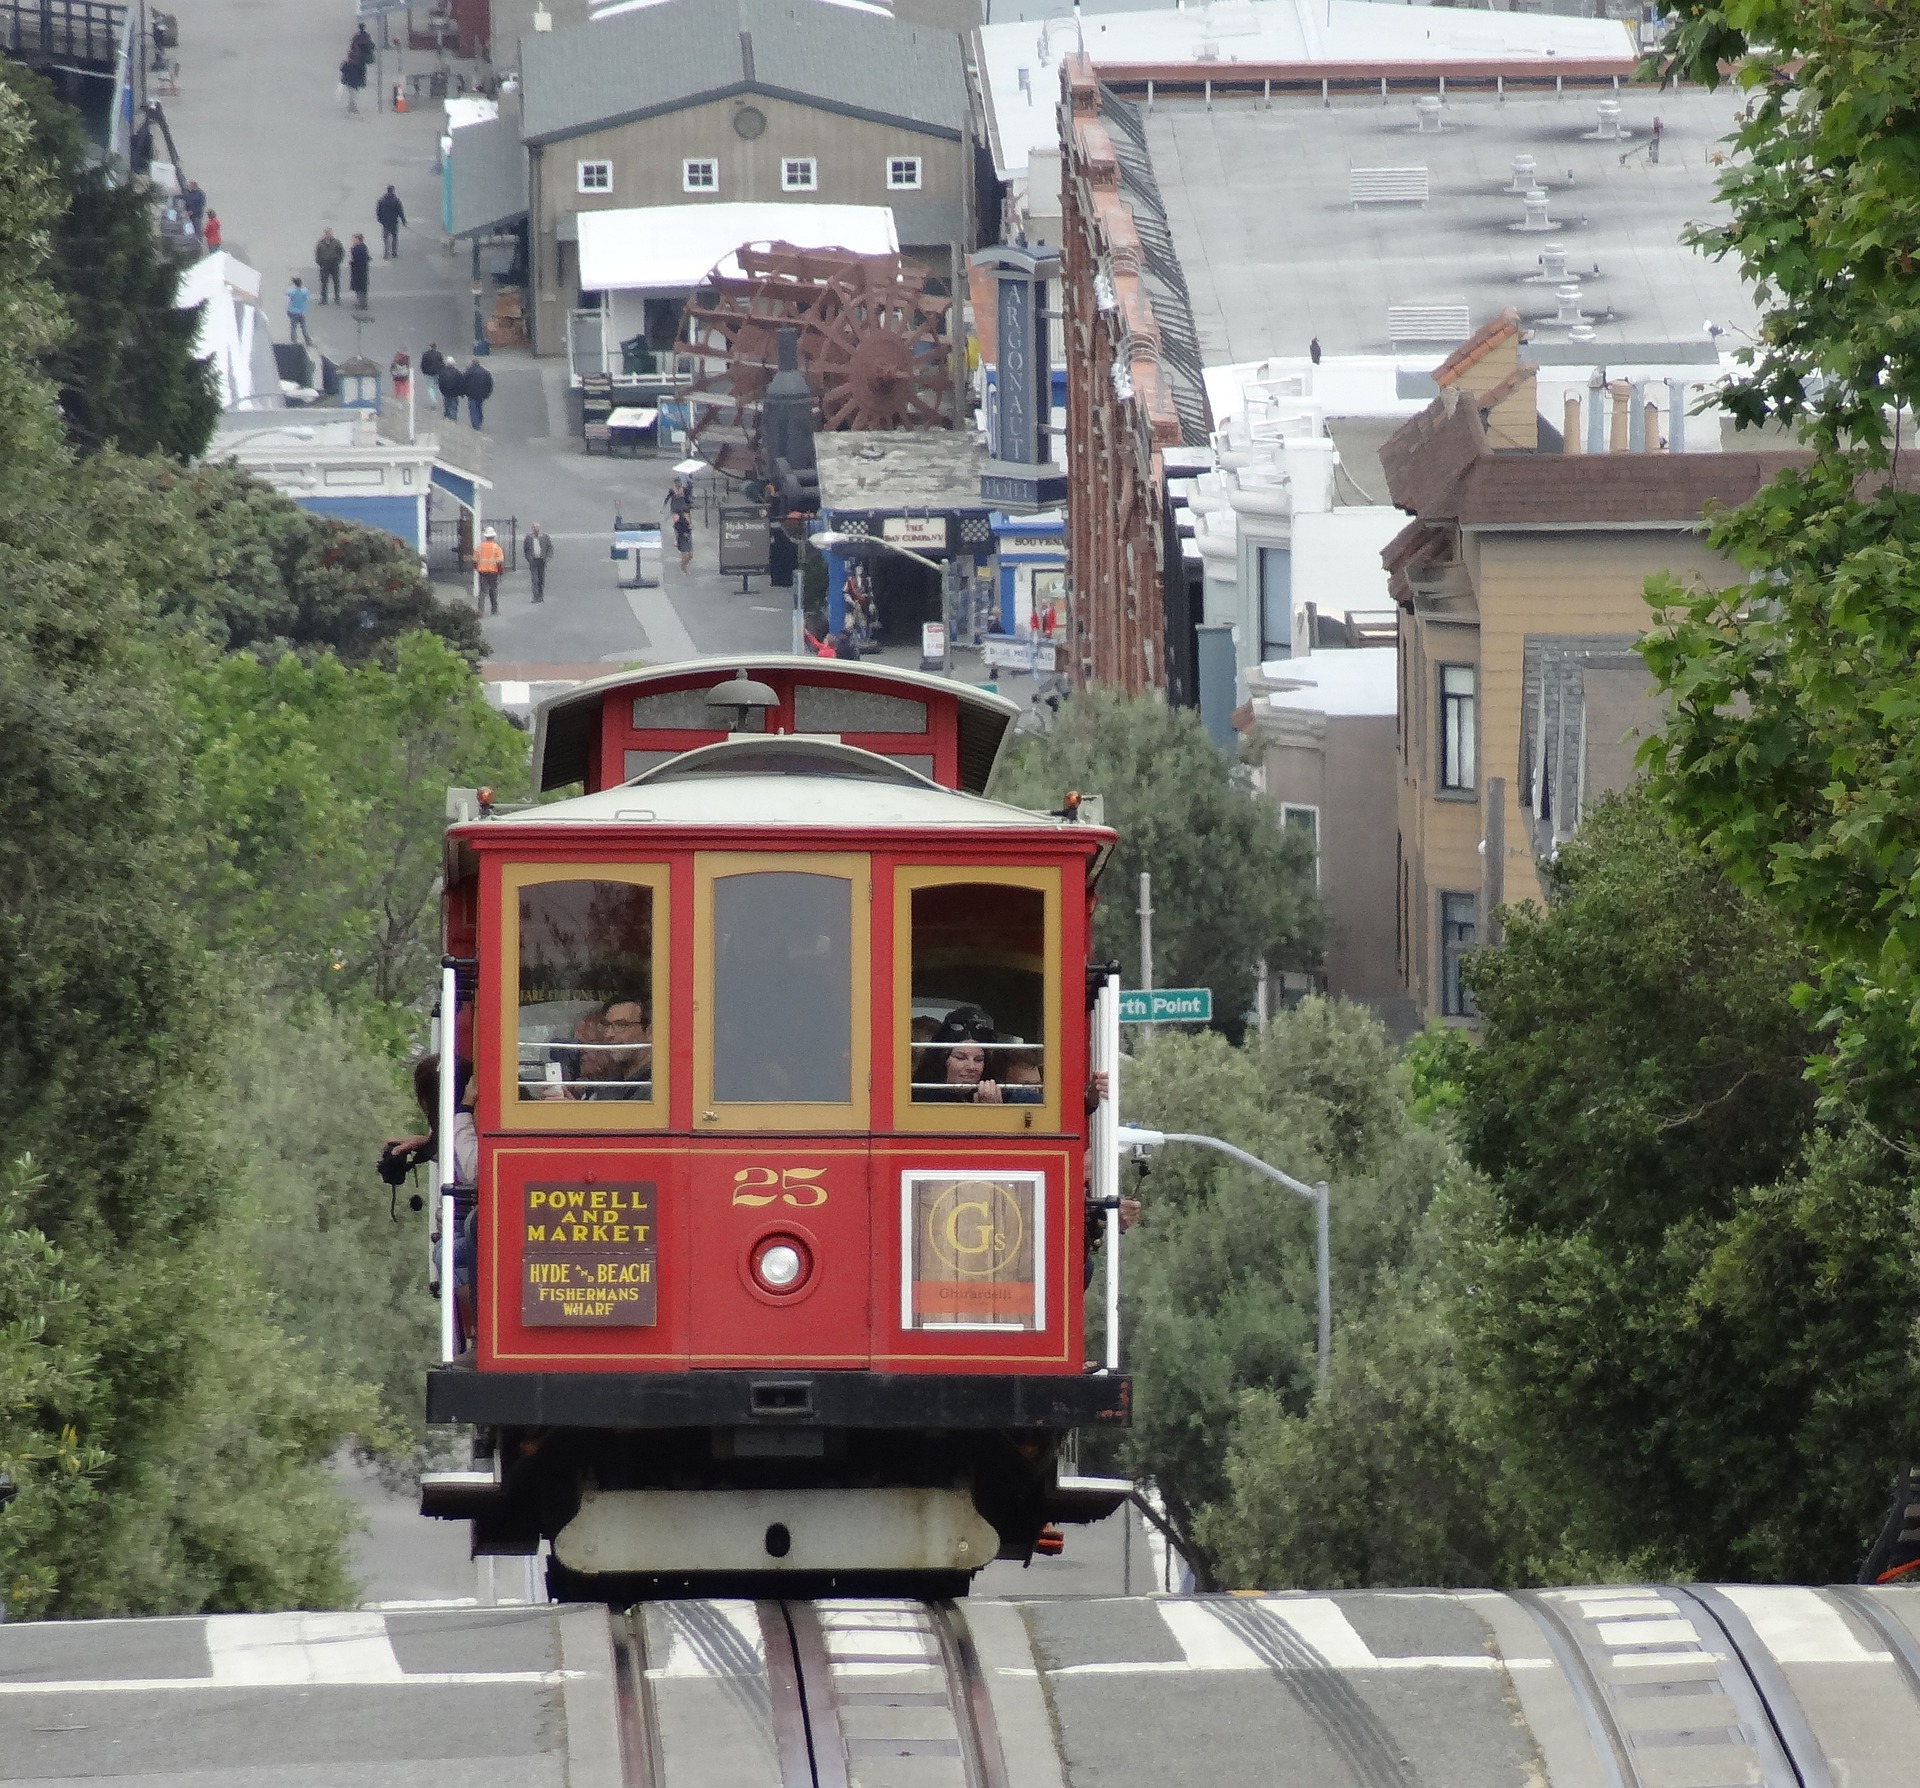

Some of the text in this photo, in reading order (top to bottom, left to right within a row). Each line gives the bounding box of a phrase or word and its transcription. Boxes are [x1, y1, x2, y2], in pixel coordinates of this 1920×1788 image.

[1006, 284, 1024, 460] ARGONAUT
[902, 533, 944, 542] COMPANY
[1153, 996, 1202, 1014] Point
[732, 1166, 828, 1207] 25
[529, 1190, 648, 1209] POWELL
[561, 1210, 619, 1224] AND
[527, 1225, 650, 1242] MARKET
[530, 1263, 571, 1283] HYDE
[597, 1263, 651, 1283] BEACH
[539, 1287, 639, 1302] FISHERMANS
[563, 1302, 615, 1316] WHARF
